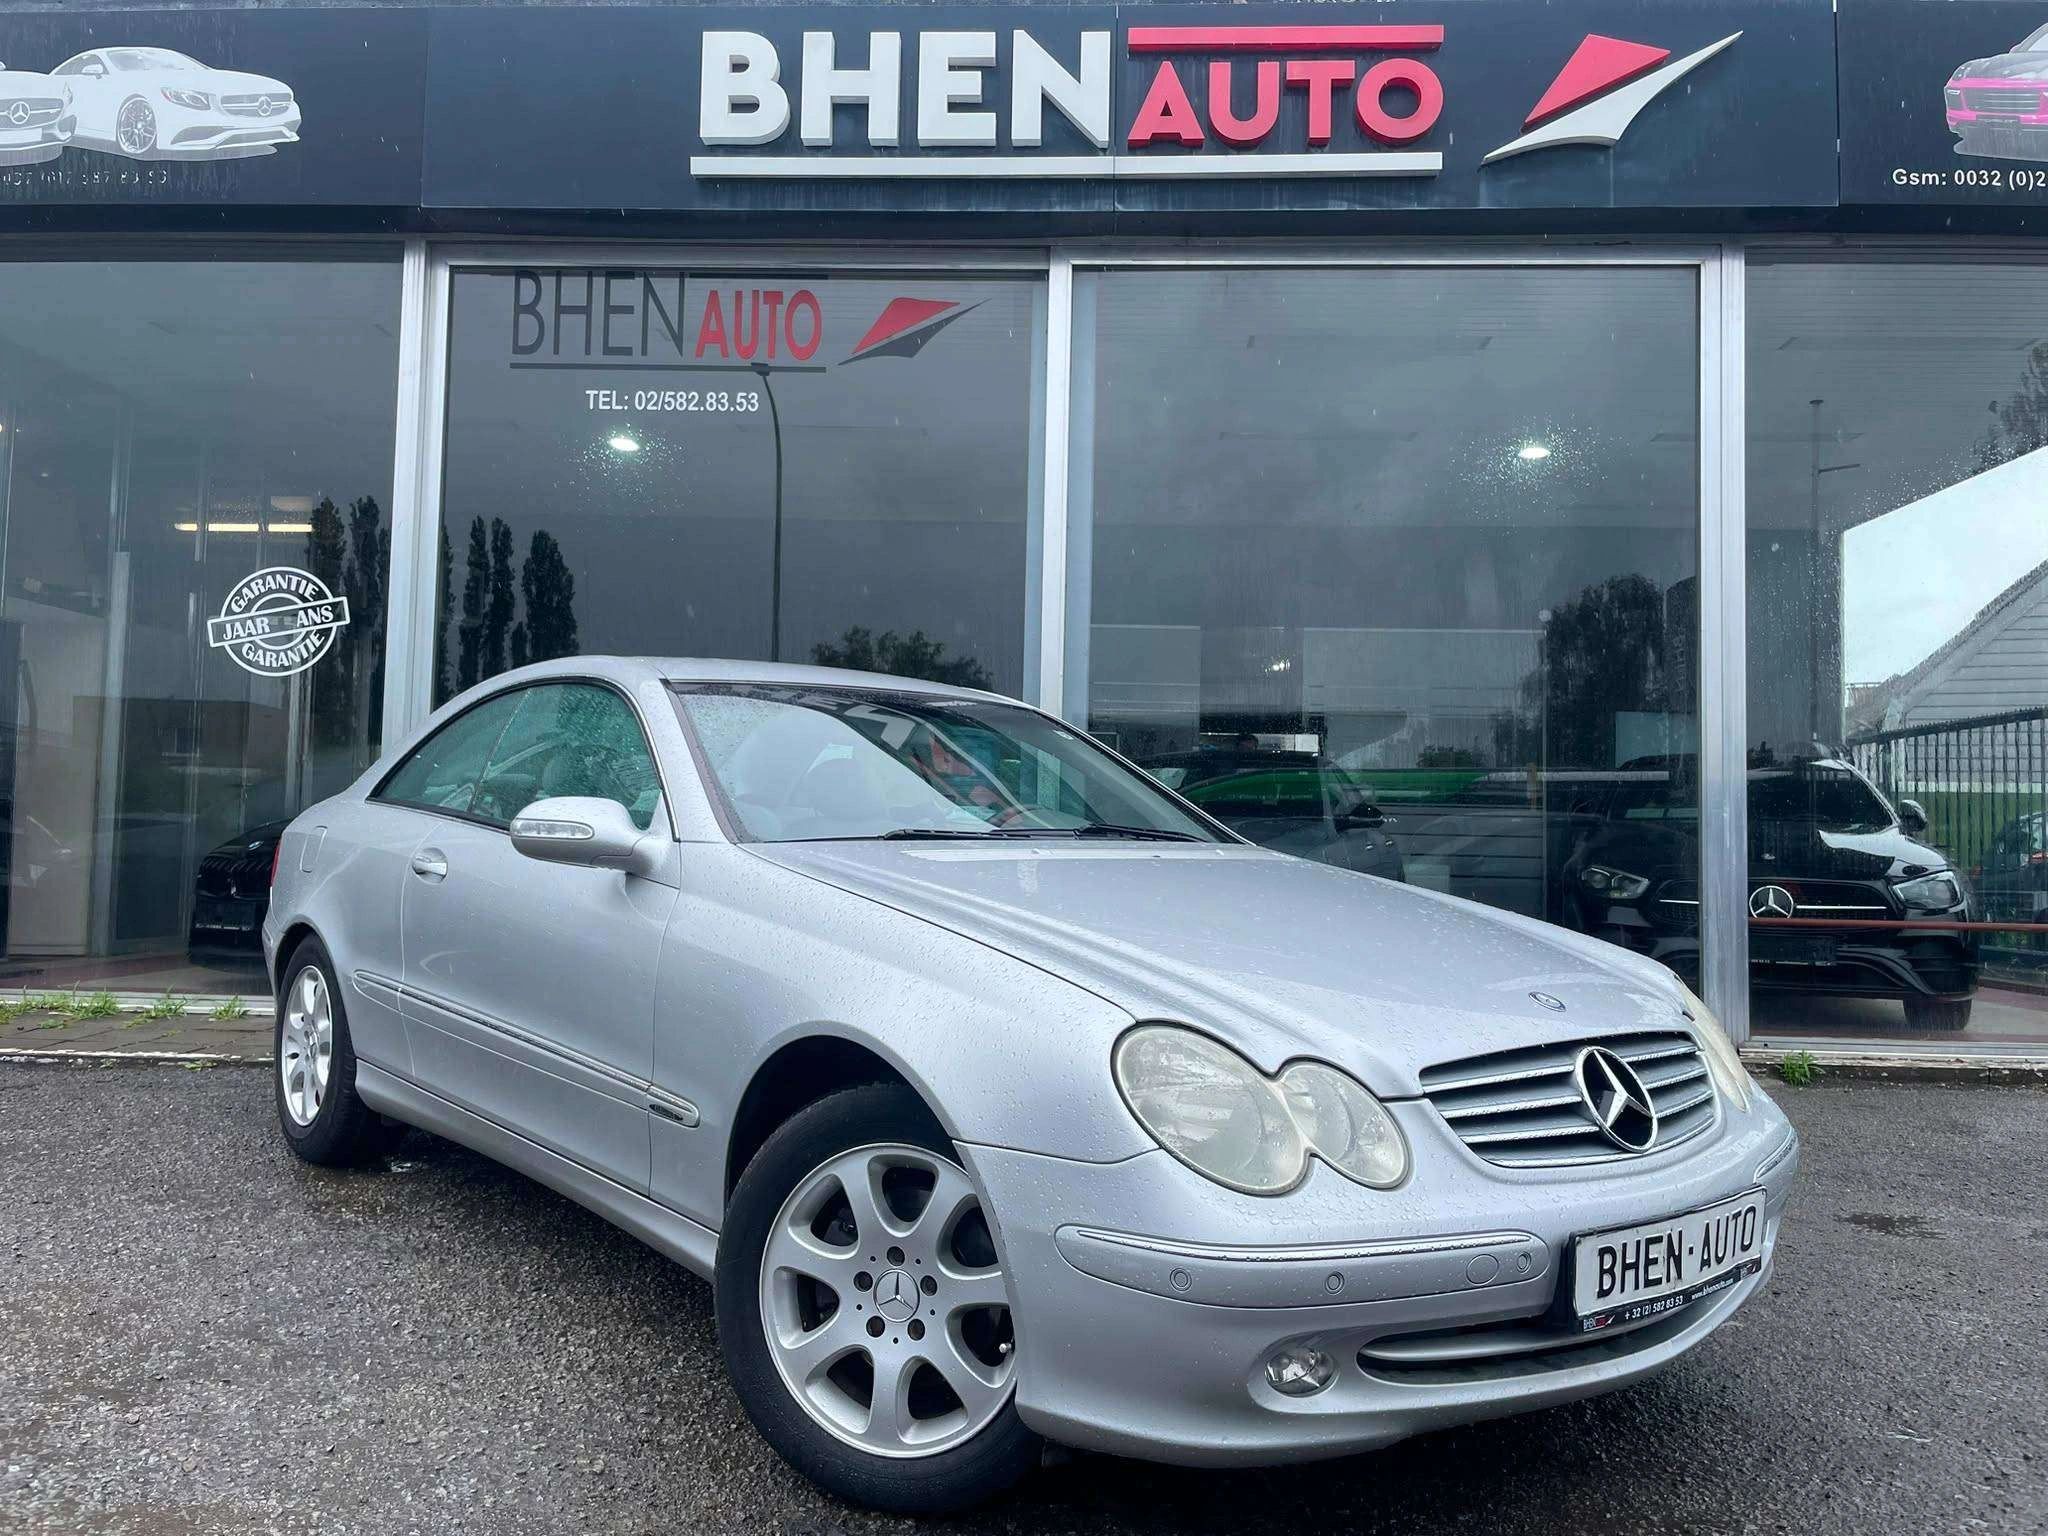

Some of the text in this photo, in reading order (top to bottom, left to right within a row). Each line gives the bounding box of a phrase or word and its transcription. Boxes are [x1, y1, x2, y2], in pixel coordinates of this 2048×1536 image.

[700, 29, 1445, 149] BHEN AUTO
[1892, 168, 1947, 186] Gsm:
[1954, 169, 2001, 186] 0032
[511, 269, 823, 361] BHEN AUTO
[585, 389, 760, 412] TEL: 02/582.83.53
[230, 573, 320, 613] GARANTIE
[222, 605, 334, 641] JAAR ANS
[241, 629, 325, 668] GARANTIE
